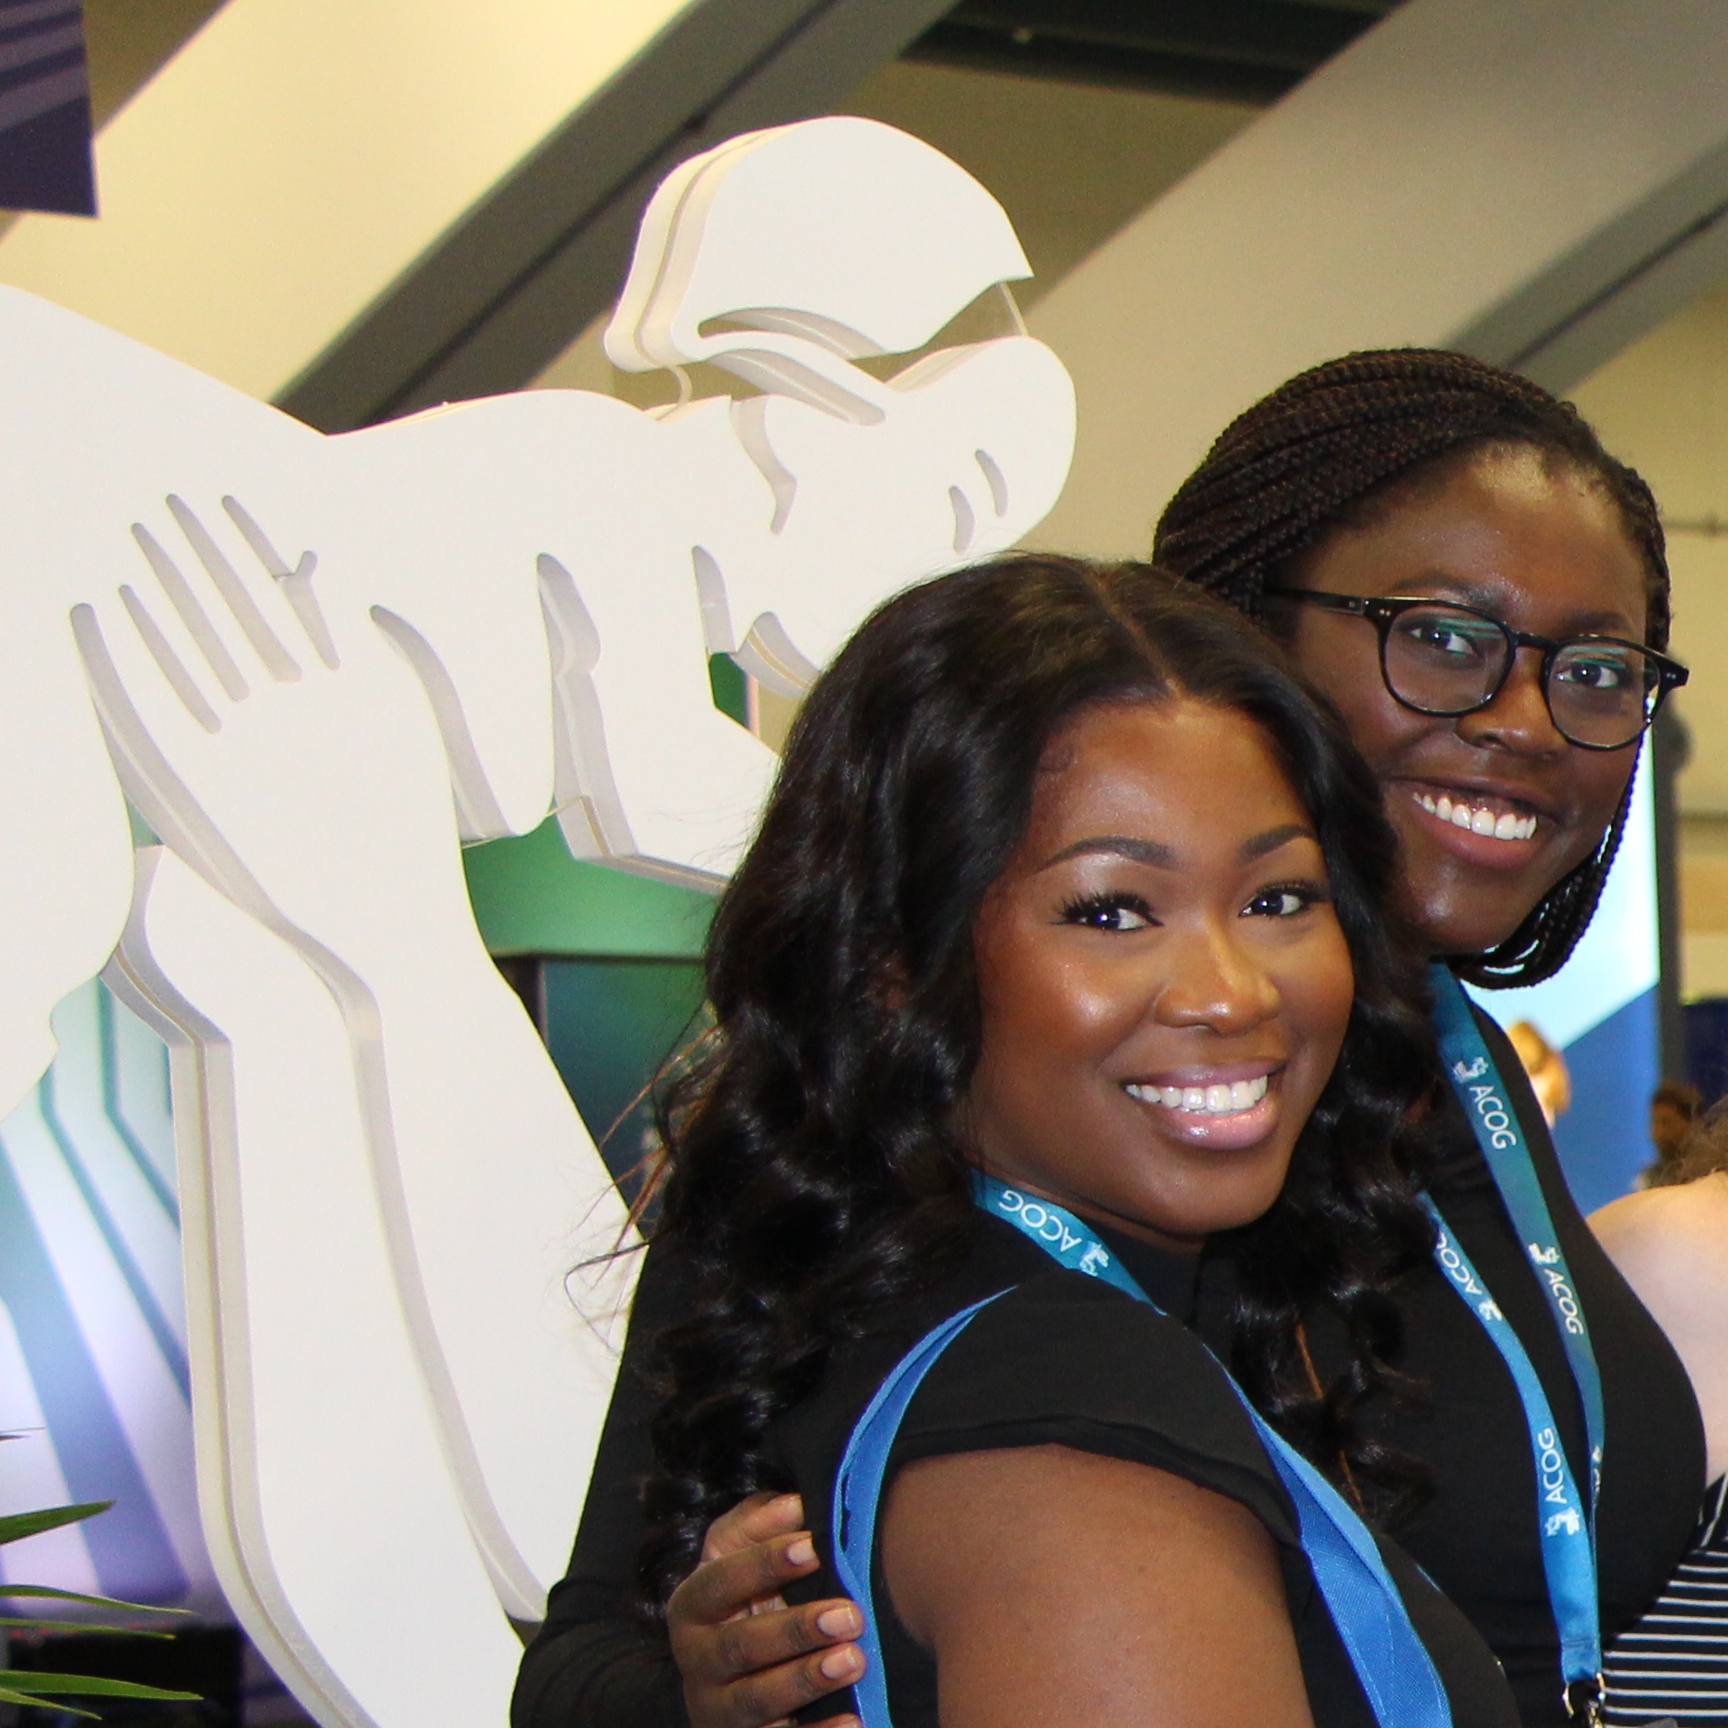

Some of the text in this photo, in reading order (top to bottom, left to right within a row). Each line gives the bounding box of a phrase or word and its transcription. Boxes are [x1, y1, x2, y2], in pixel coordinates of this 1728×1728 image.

[1470, 1085, 1517, 1150] ACOG
[998, 1189, 1083, 1252] ACOG
[1544, 1268, 1584, 1335] ACOG
[1537, 1427, 1568, 1504] ACOG
